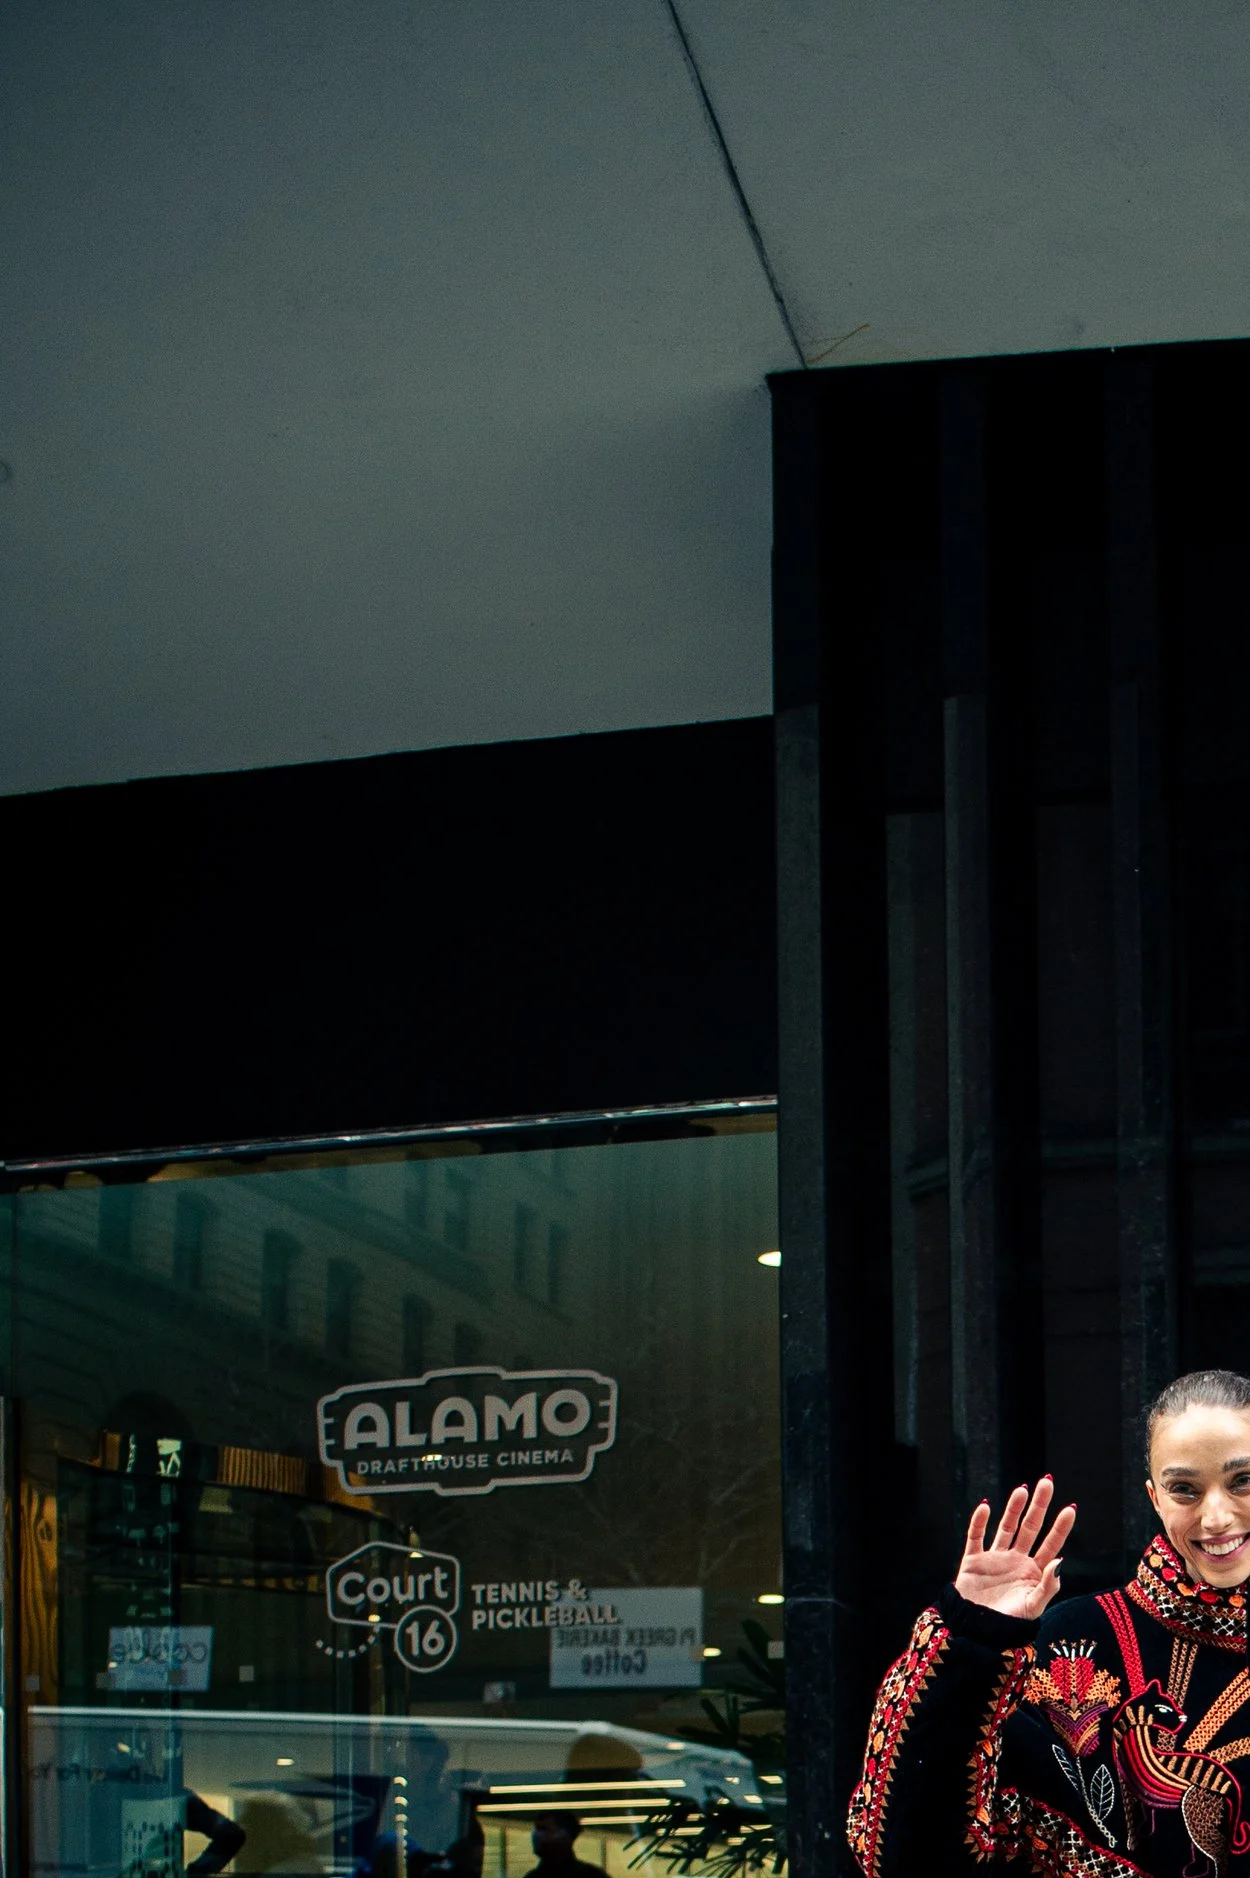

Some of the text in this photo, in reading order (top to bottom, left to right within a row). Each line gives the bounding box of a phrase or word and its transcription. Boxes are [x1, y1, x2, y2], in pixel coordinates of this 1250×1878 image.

[343, 1389, 591, 1450] ALAMO
[356, 1449, 574, 1476] DRAFTHOUSE CINEMA
[337, 1566, 449, 1606] Court
[471, 1578, 589, 1604] TENNIS &
[471, 1604, 618, 1631] PICKLEBALL
[405, 1619, 446, 1657] 16
